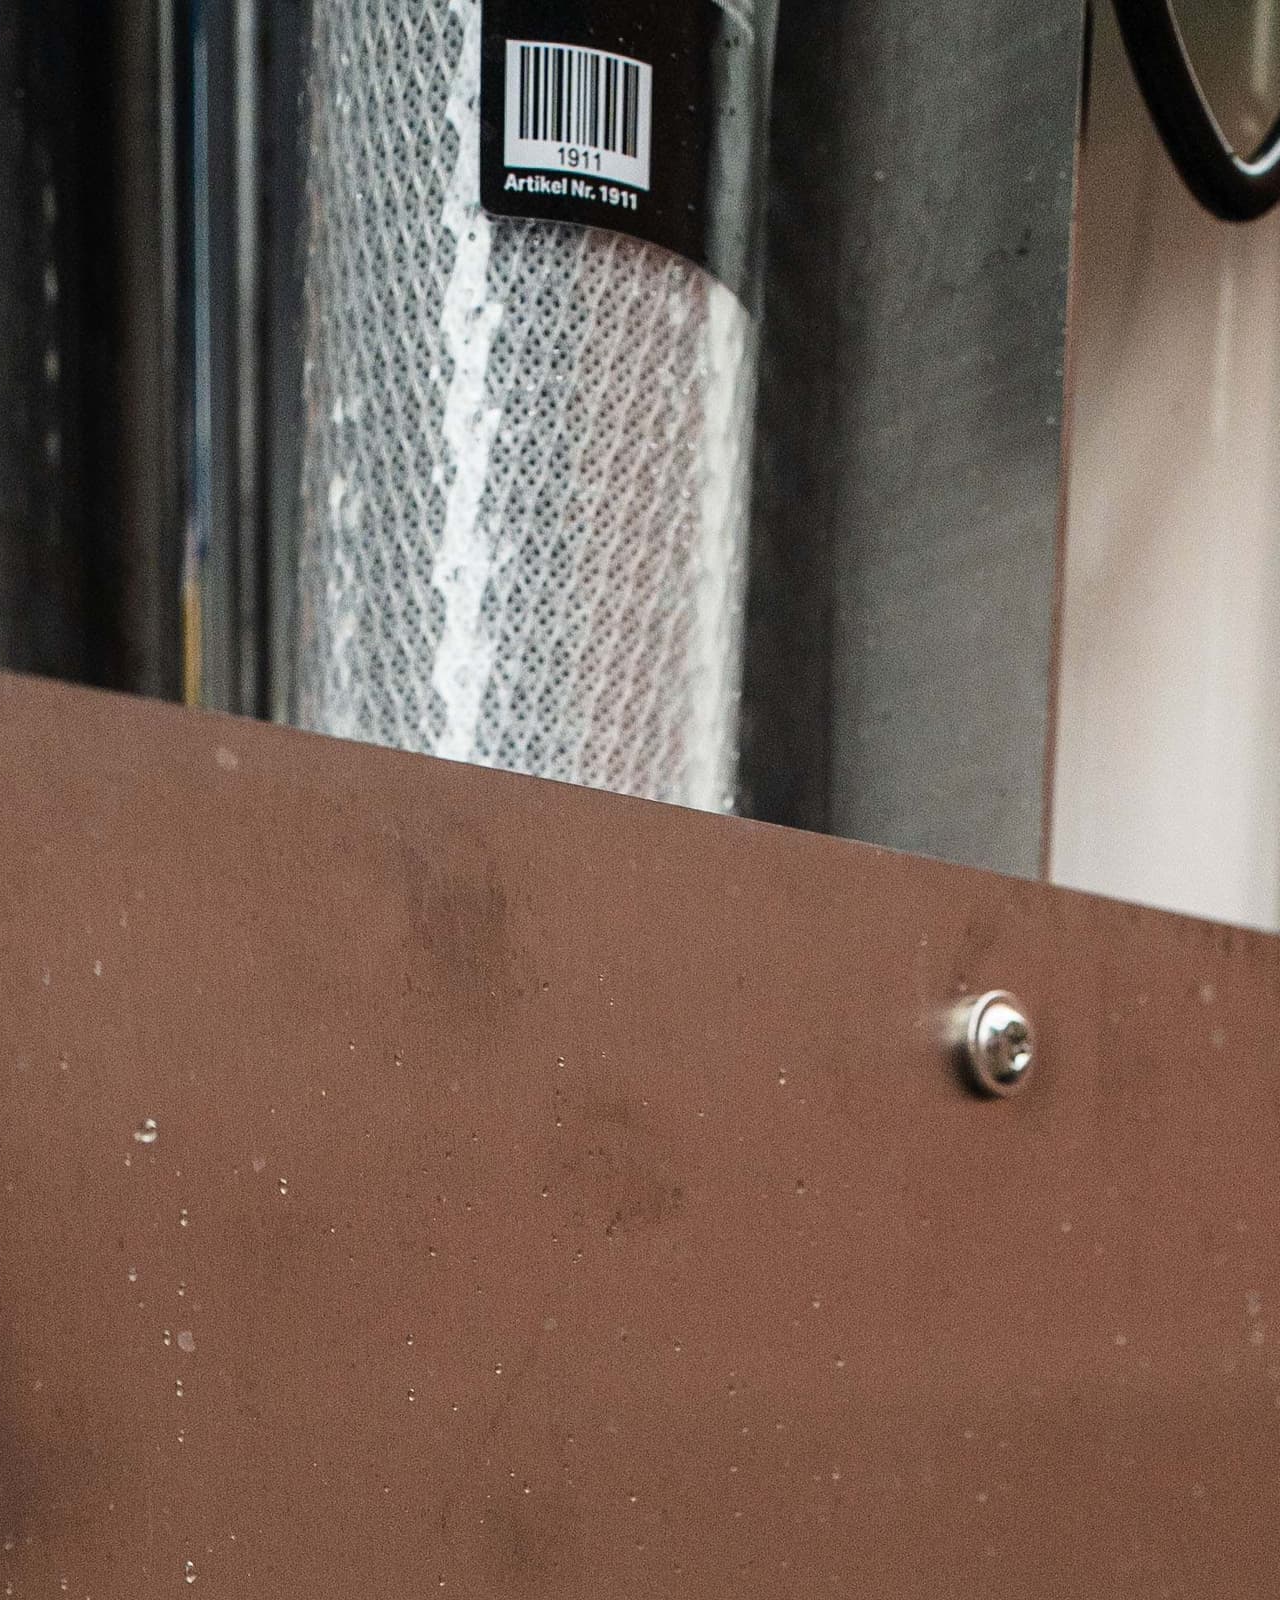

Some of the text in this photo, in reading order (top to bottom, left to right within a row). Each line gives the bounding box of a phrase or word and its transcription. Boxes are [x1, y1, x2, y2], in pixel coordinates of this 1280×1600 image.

[558, 147, 601, 172] 1911
[504, 173, 638, 211] Artikel Nr. 1911
